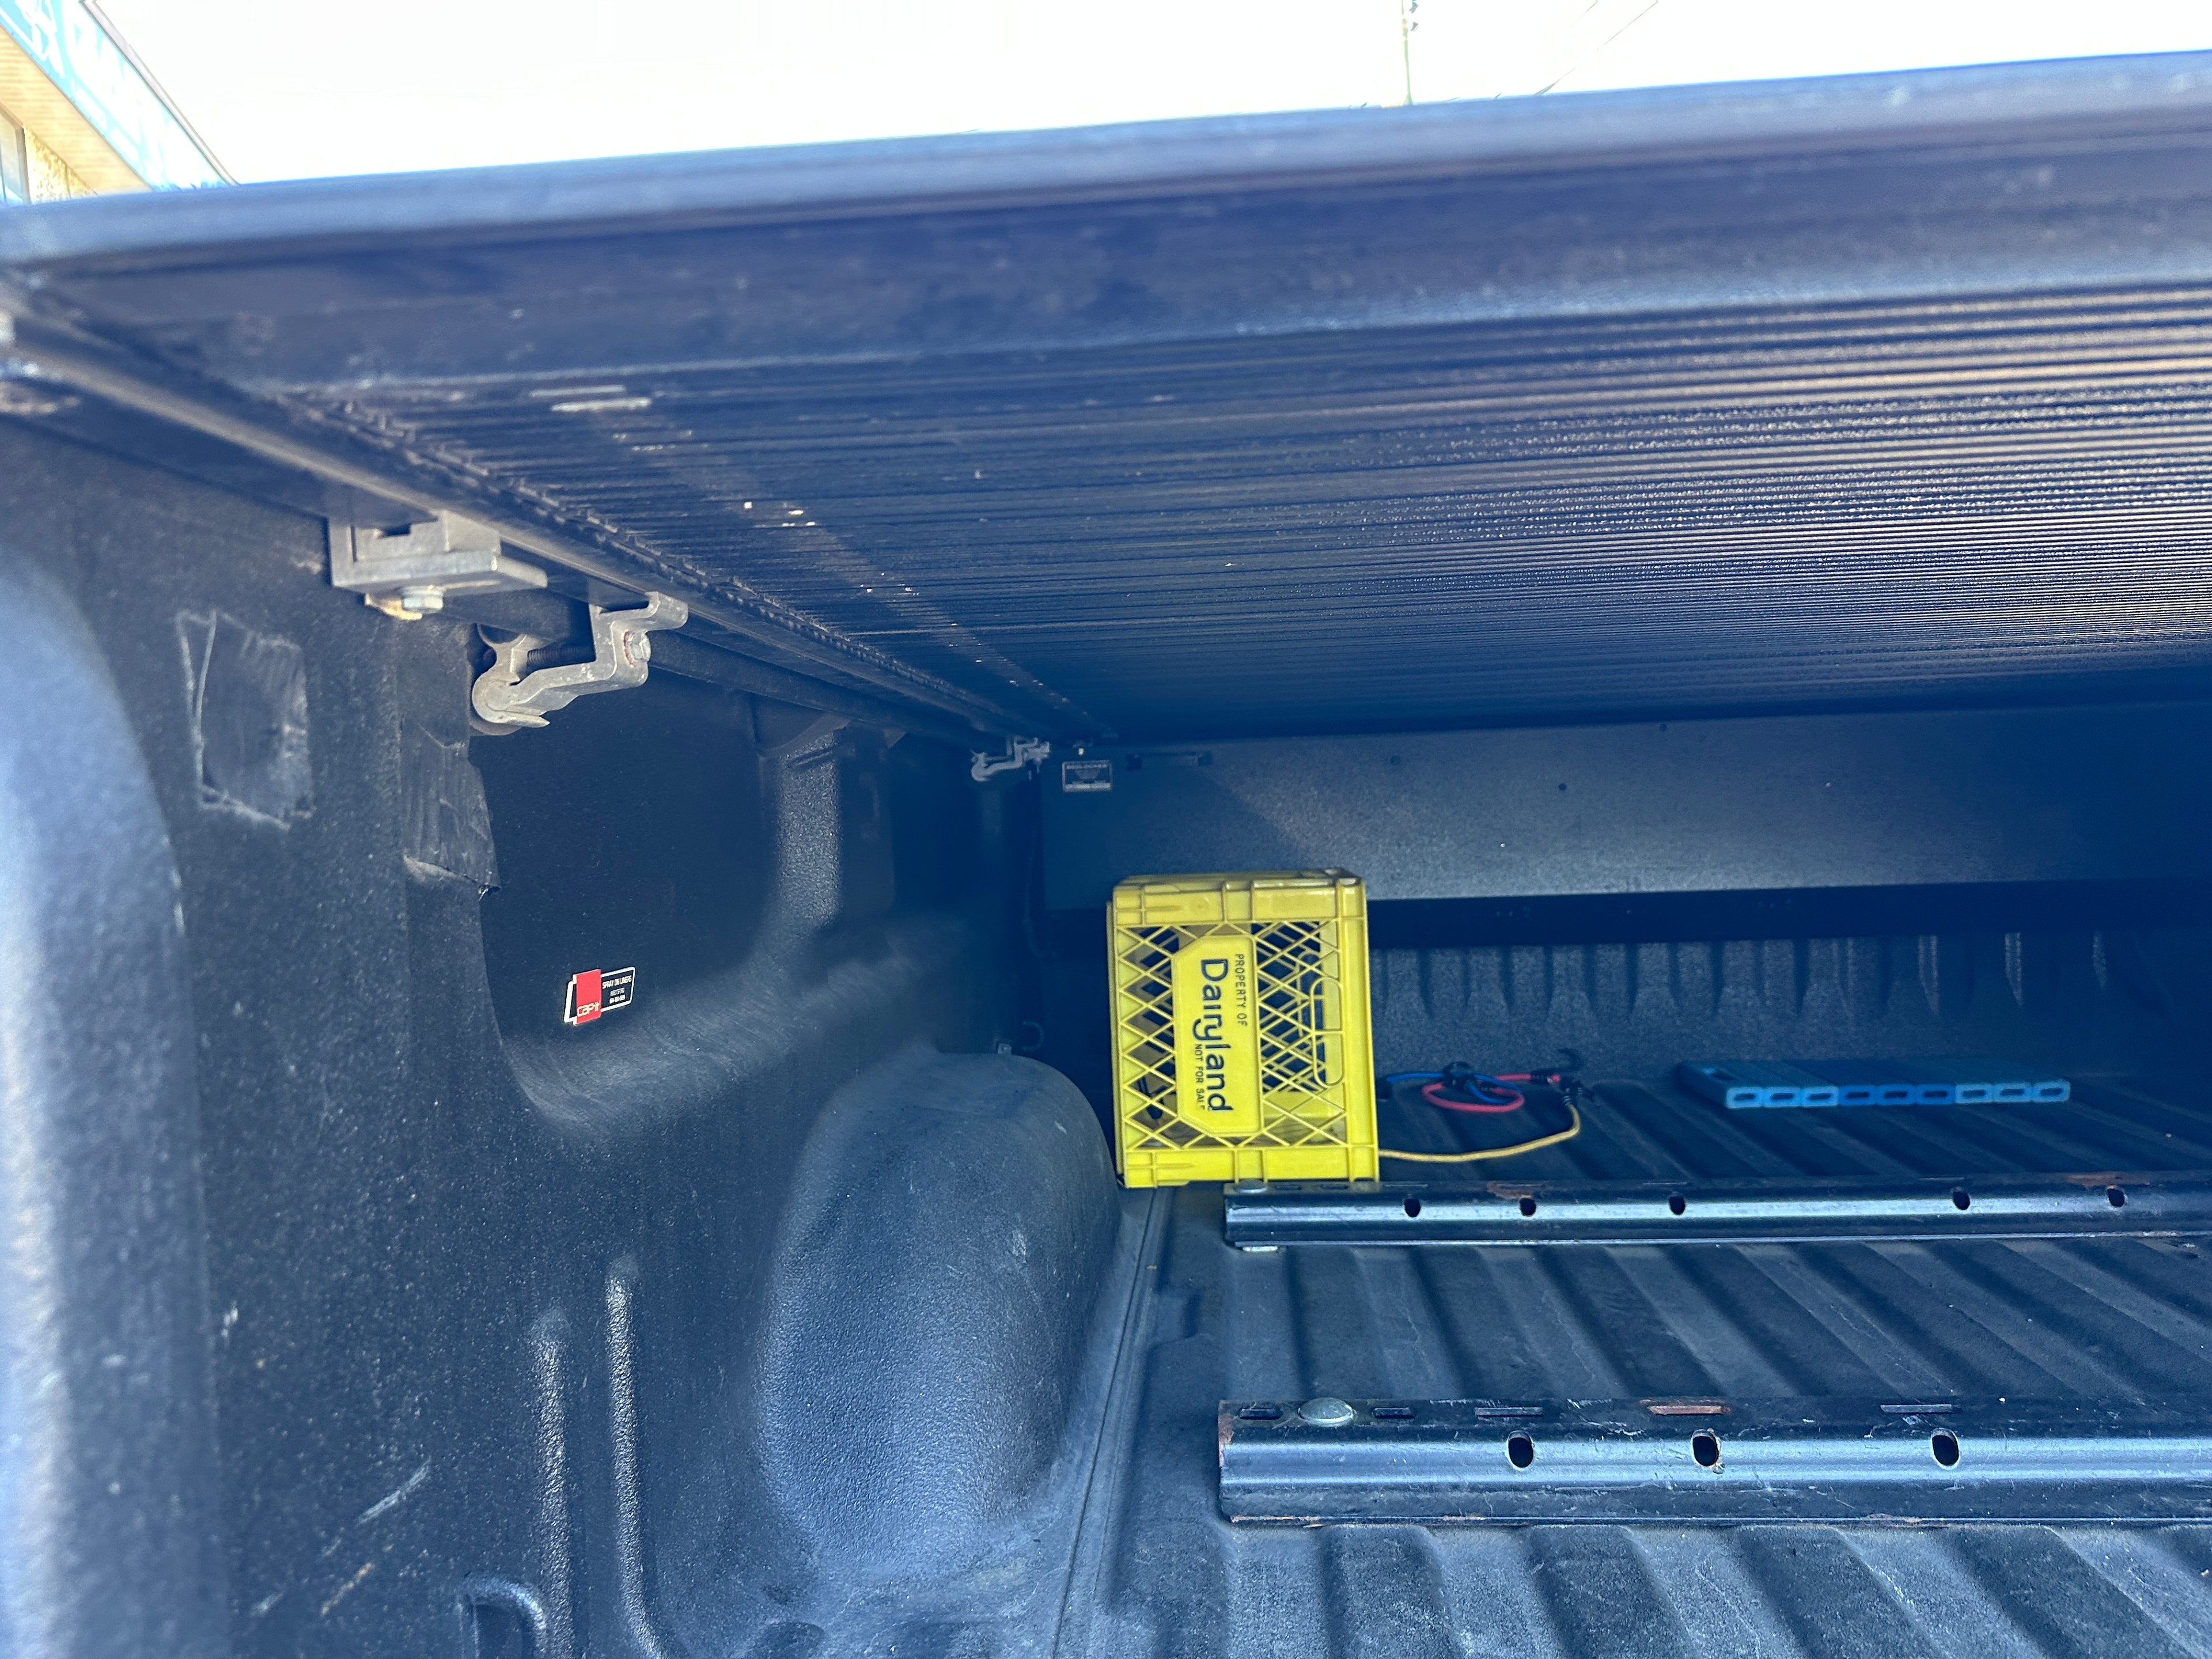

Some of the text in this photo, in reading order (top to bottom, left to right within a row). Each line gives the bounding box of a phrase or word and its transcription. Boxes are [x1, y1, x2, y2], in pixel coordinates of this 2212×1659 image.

[1234, 954, 1248, 1027] PROPERTY OF
[1192, 959, 1233, 1111] Dairyland
[1195, 1044, 1203, 1062] NOT
[1195, 1066, 1204, 1084] FOR
